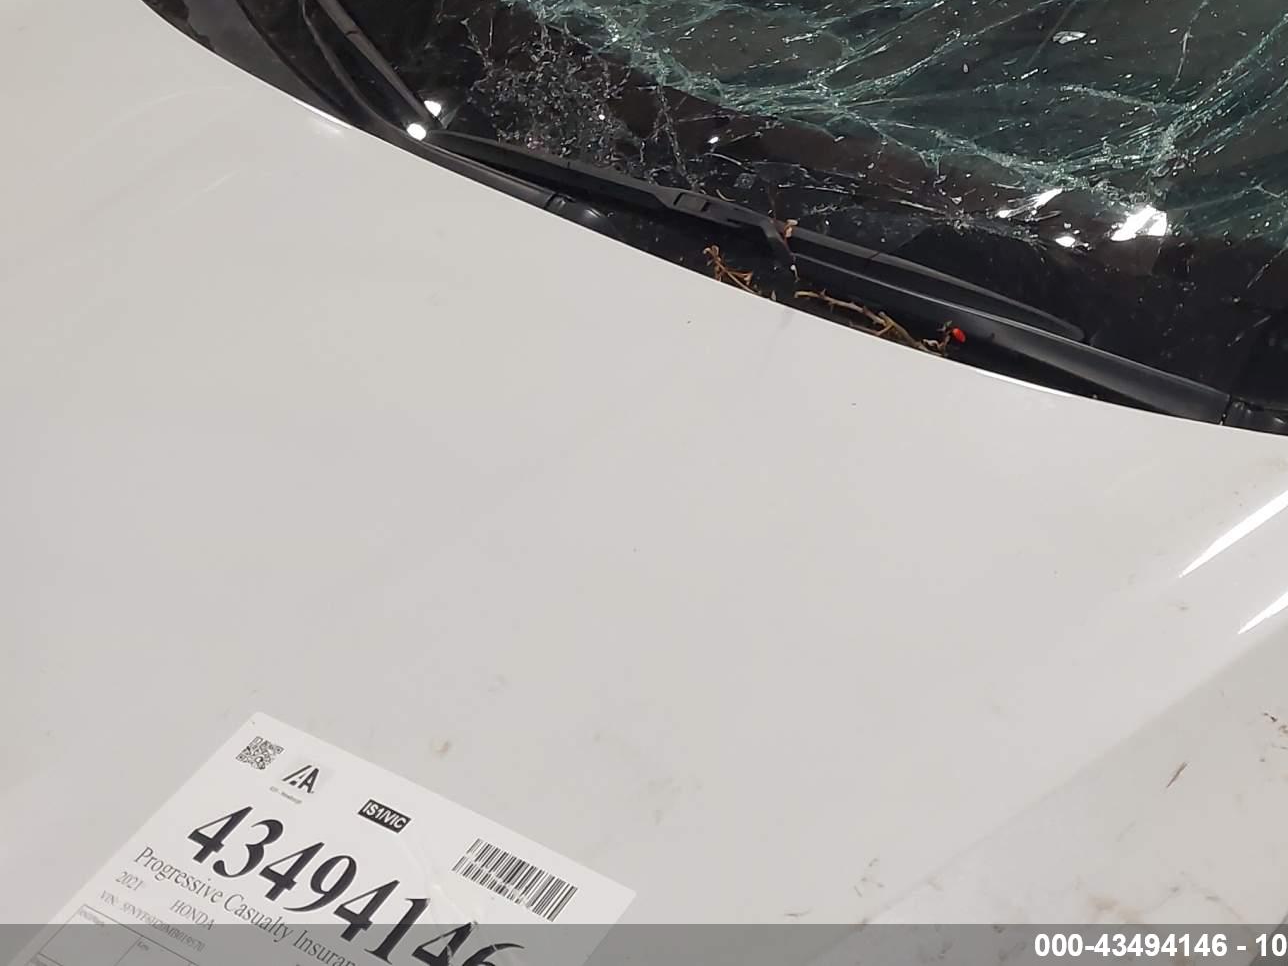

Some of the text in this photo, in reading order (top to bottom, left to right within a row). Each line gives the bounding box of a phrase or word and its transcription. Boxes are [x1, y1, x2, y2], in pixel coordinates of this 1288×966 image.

[115, 871, 216, 931] 2021 HONDA
[133, 846, 223, 904] Progressive
[224, 894, 294, 943] Casualty
